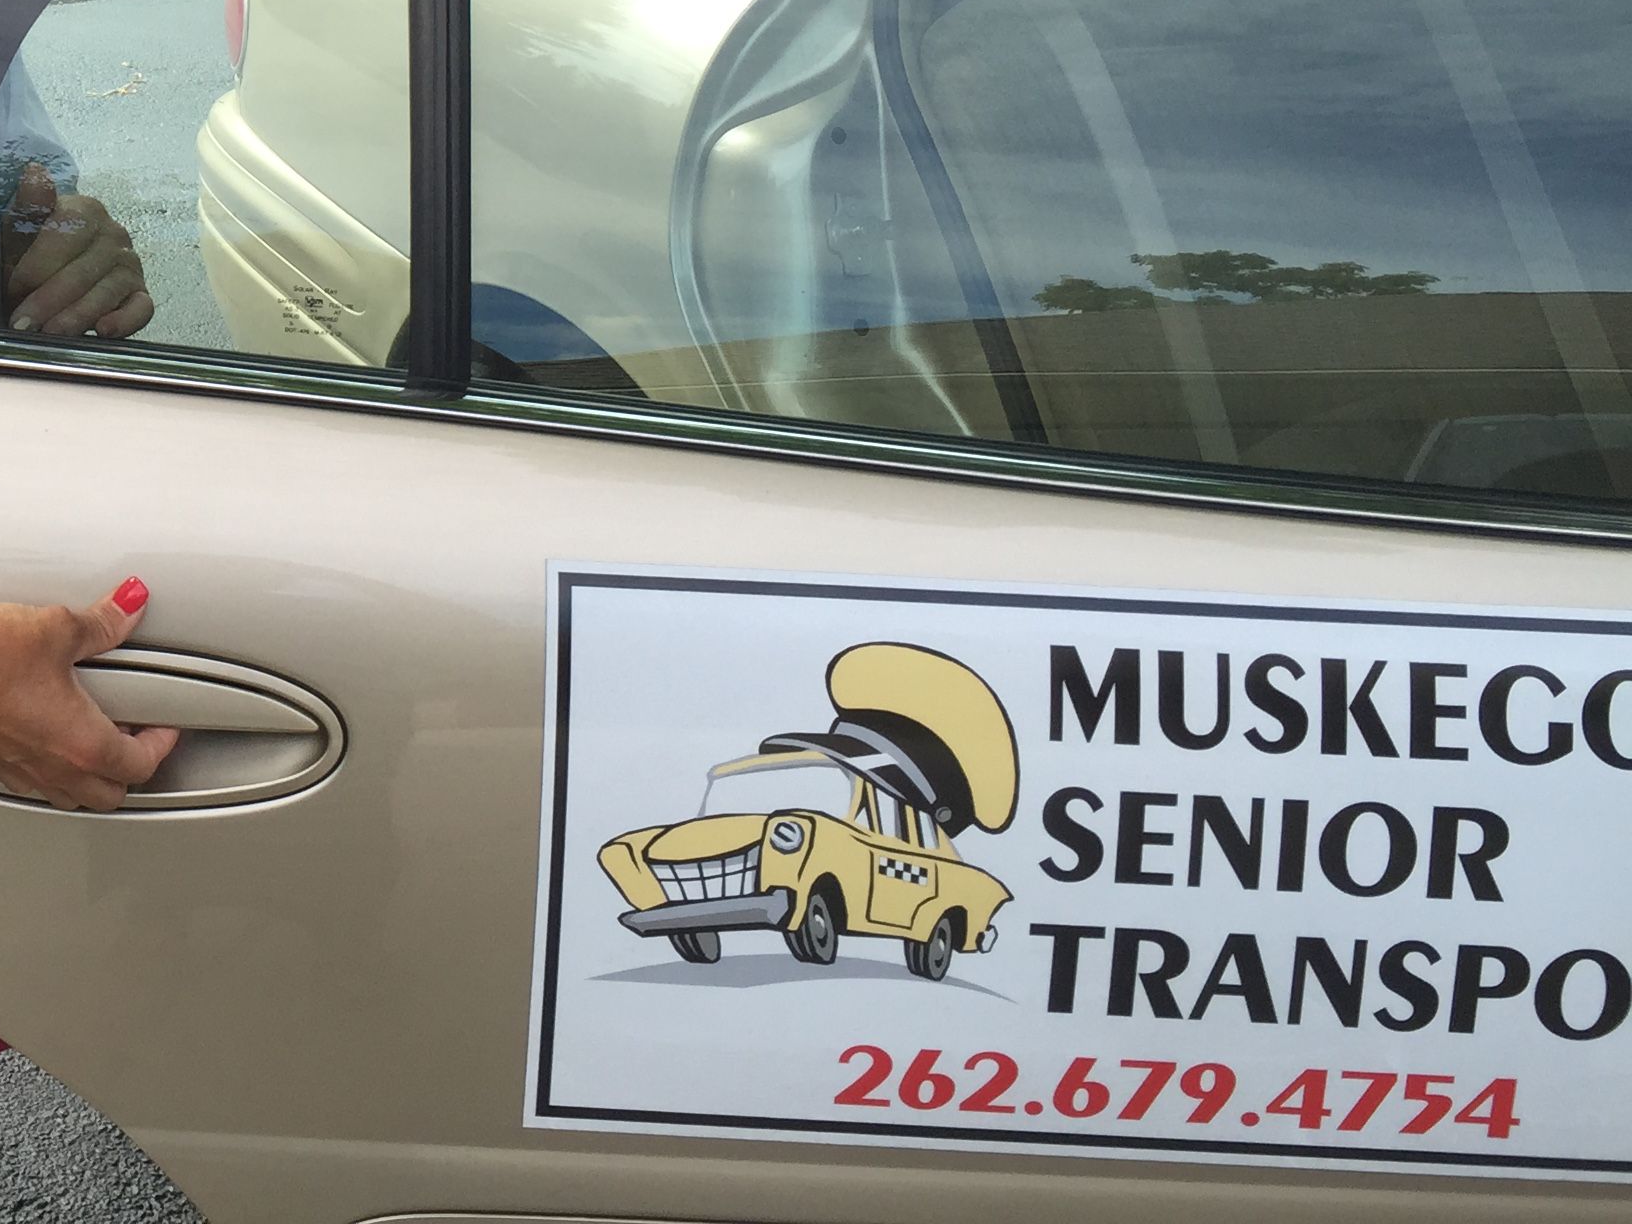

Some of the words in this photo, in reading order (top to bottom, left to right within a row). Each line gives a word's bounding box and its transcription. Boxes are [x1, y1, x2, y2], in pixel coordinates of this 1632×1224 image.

[1038, 786, 1510, 902] SENIOR
[1029, 922, 1632, 1041] TRANSPO
[833, 1045, 1521, 1140] 262.679.4754
